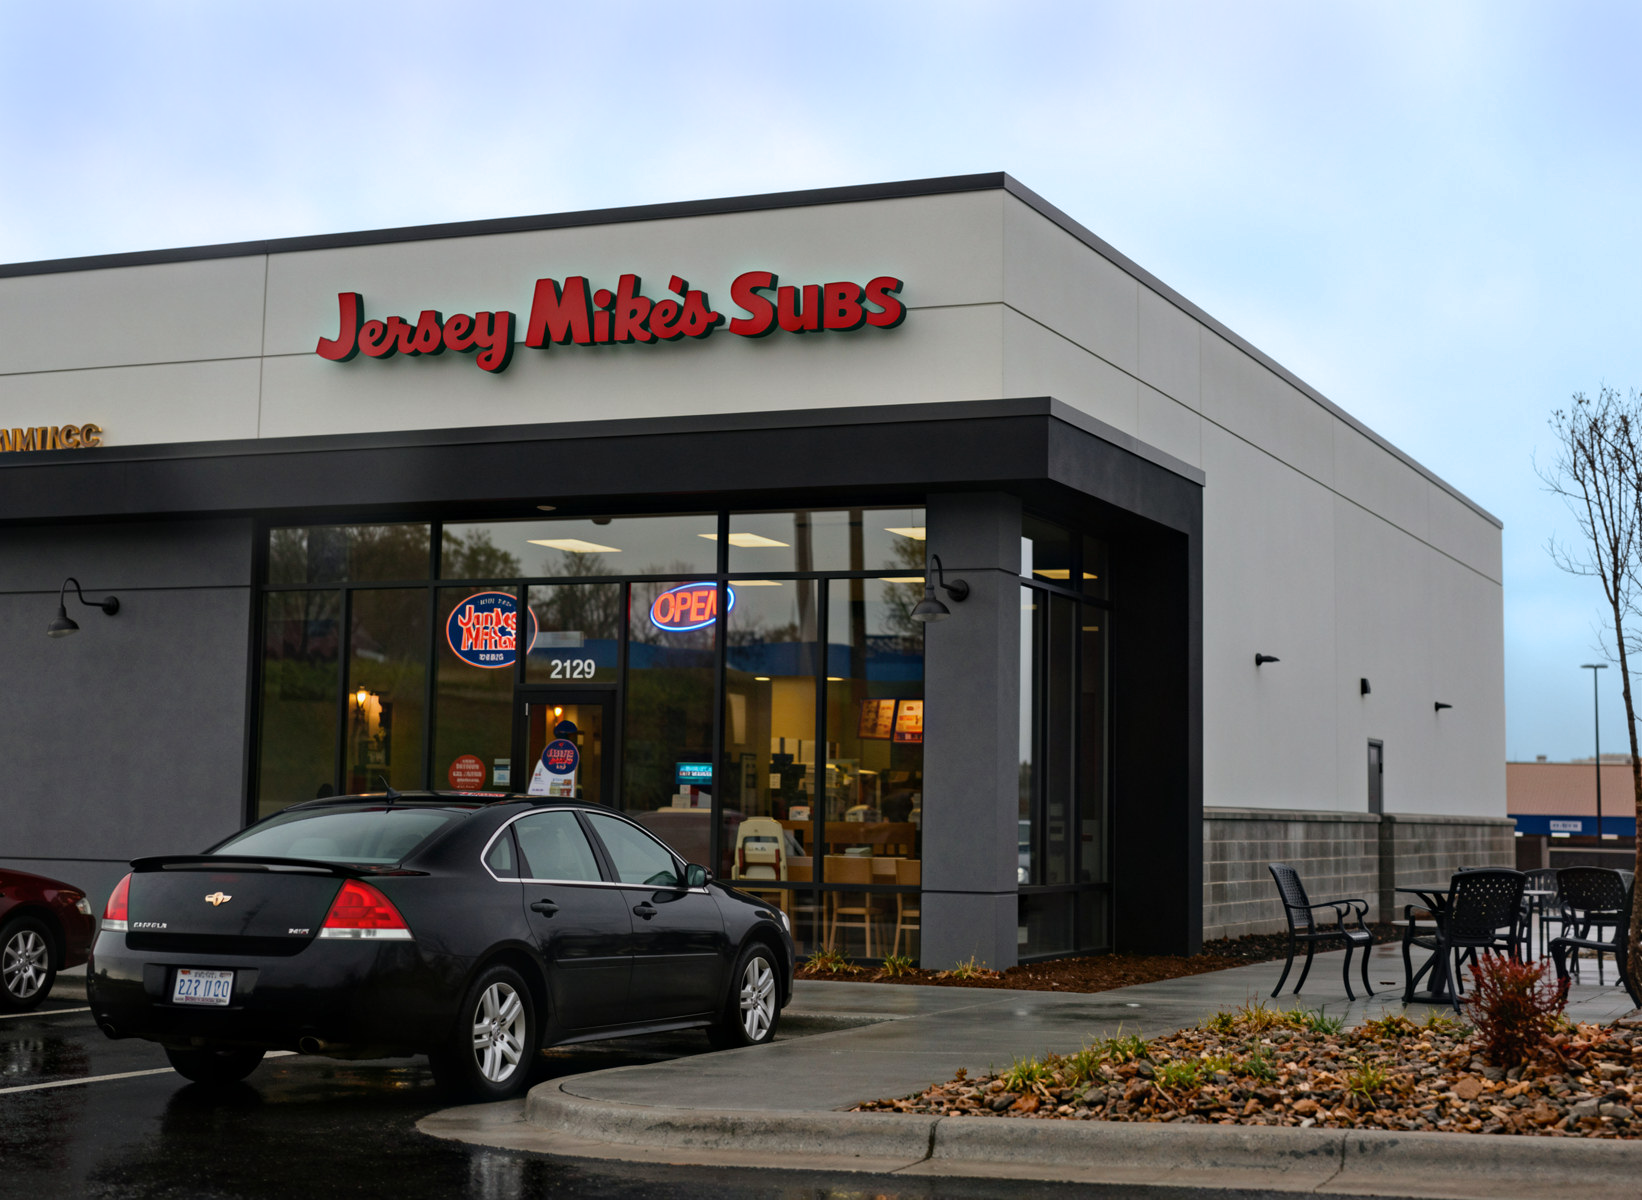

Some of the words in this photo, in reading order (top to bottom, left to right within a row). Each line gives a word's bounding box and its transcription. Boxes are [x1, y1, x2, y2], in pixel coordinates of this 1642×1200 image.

[316, 293, 512, 372] Jersey
[525, 274, 721, 348] Mike's
[550, 659, 596, 679] 2129
